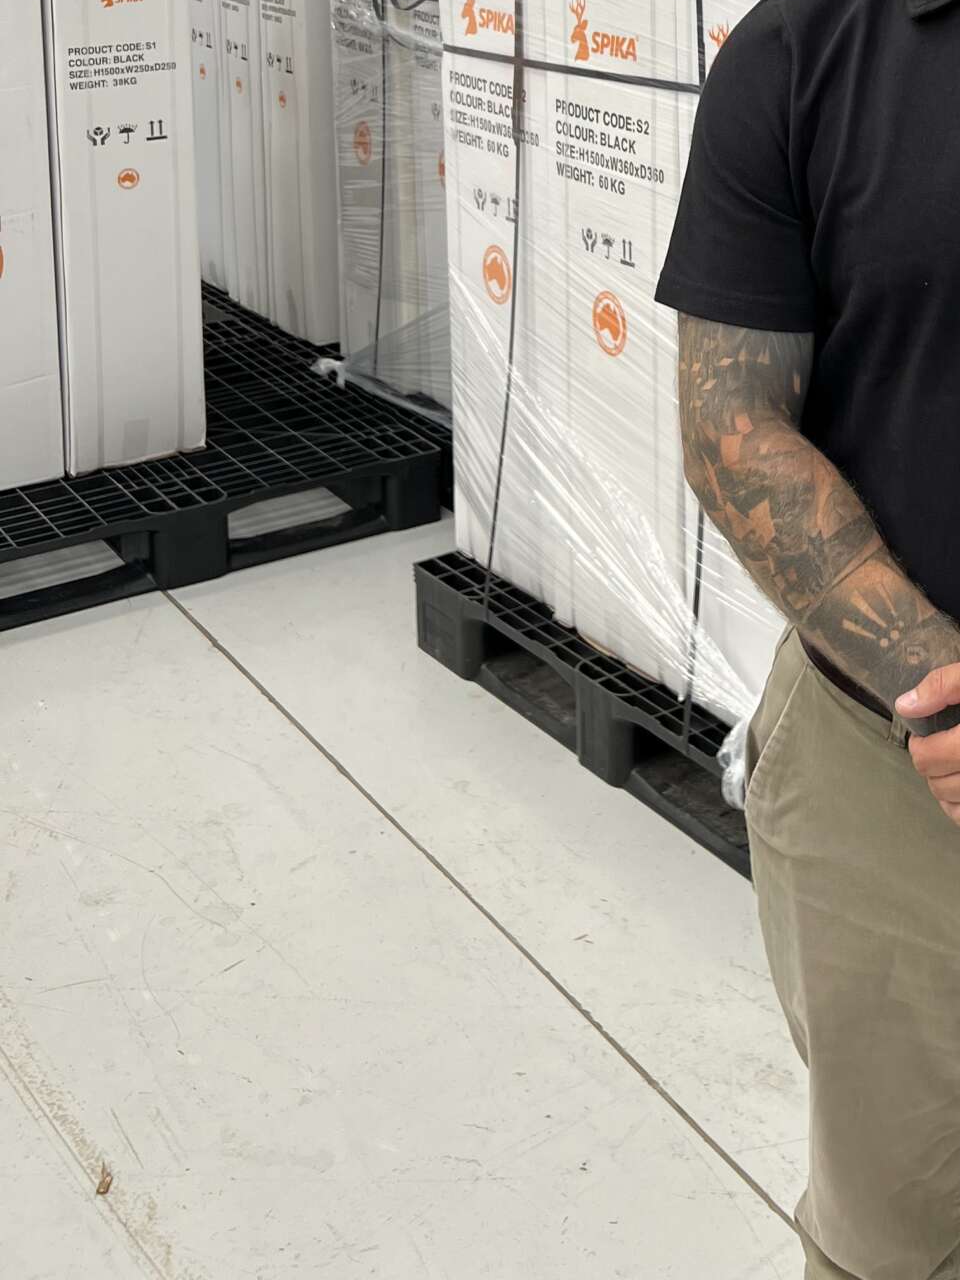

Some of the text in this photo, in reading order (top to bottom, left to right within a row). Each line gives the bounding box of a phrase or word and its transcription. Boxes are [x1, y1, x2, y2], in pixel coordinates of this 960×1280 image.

[478, 7, 515, 35] SPIKA
[68, 45, 113, 56] PRODUCT
[591, 31, 637, 62] SPIKA
[68, 54, 145, 68] COLOUR: BLACK
[69, 79, 109, 91] WEIGHT:
[449, 70, 487, 94] PRODUCT
[450, 91, 513, 120] COLOUR: BLAC
[555, 98, 601, 124] PRODUCT
[555, 120, 636, 155] COLOUR: BLACK
[556, 161, 595, 187] WEIGHT:
